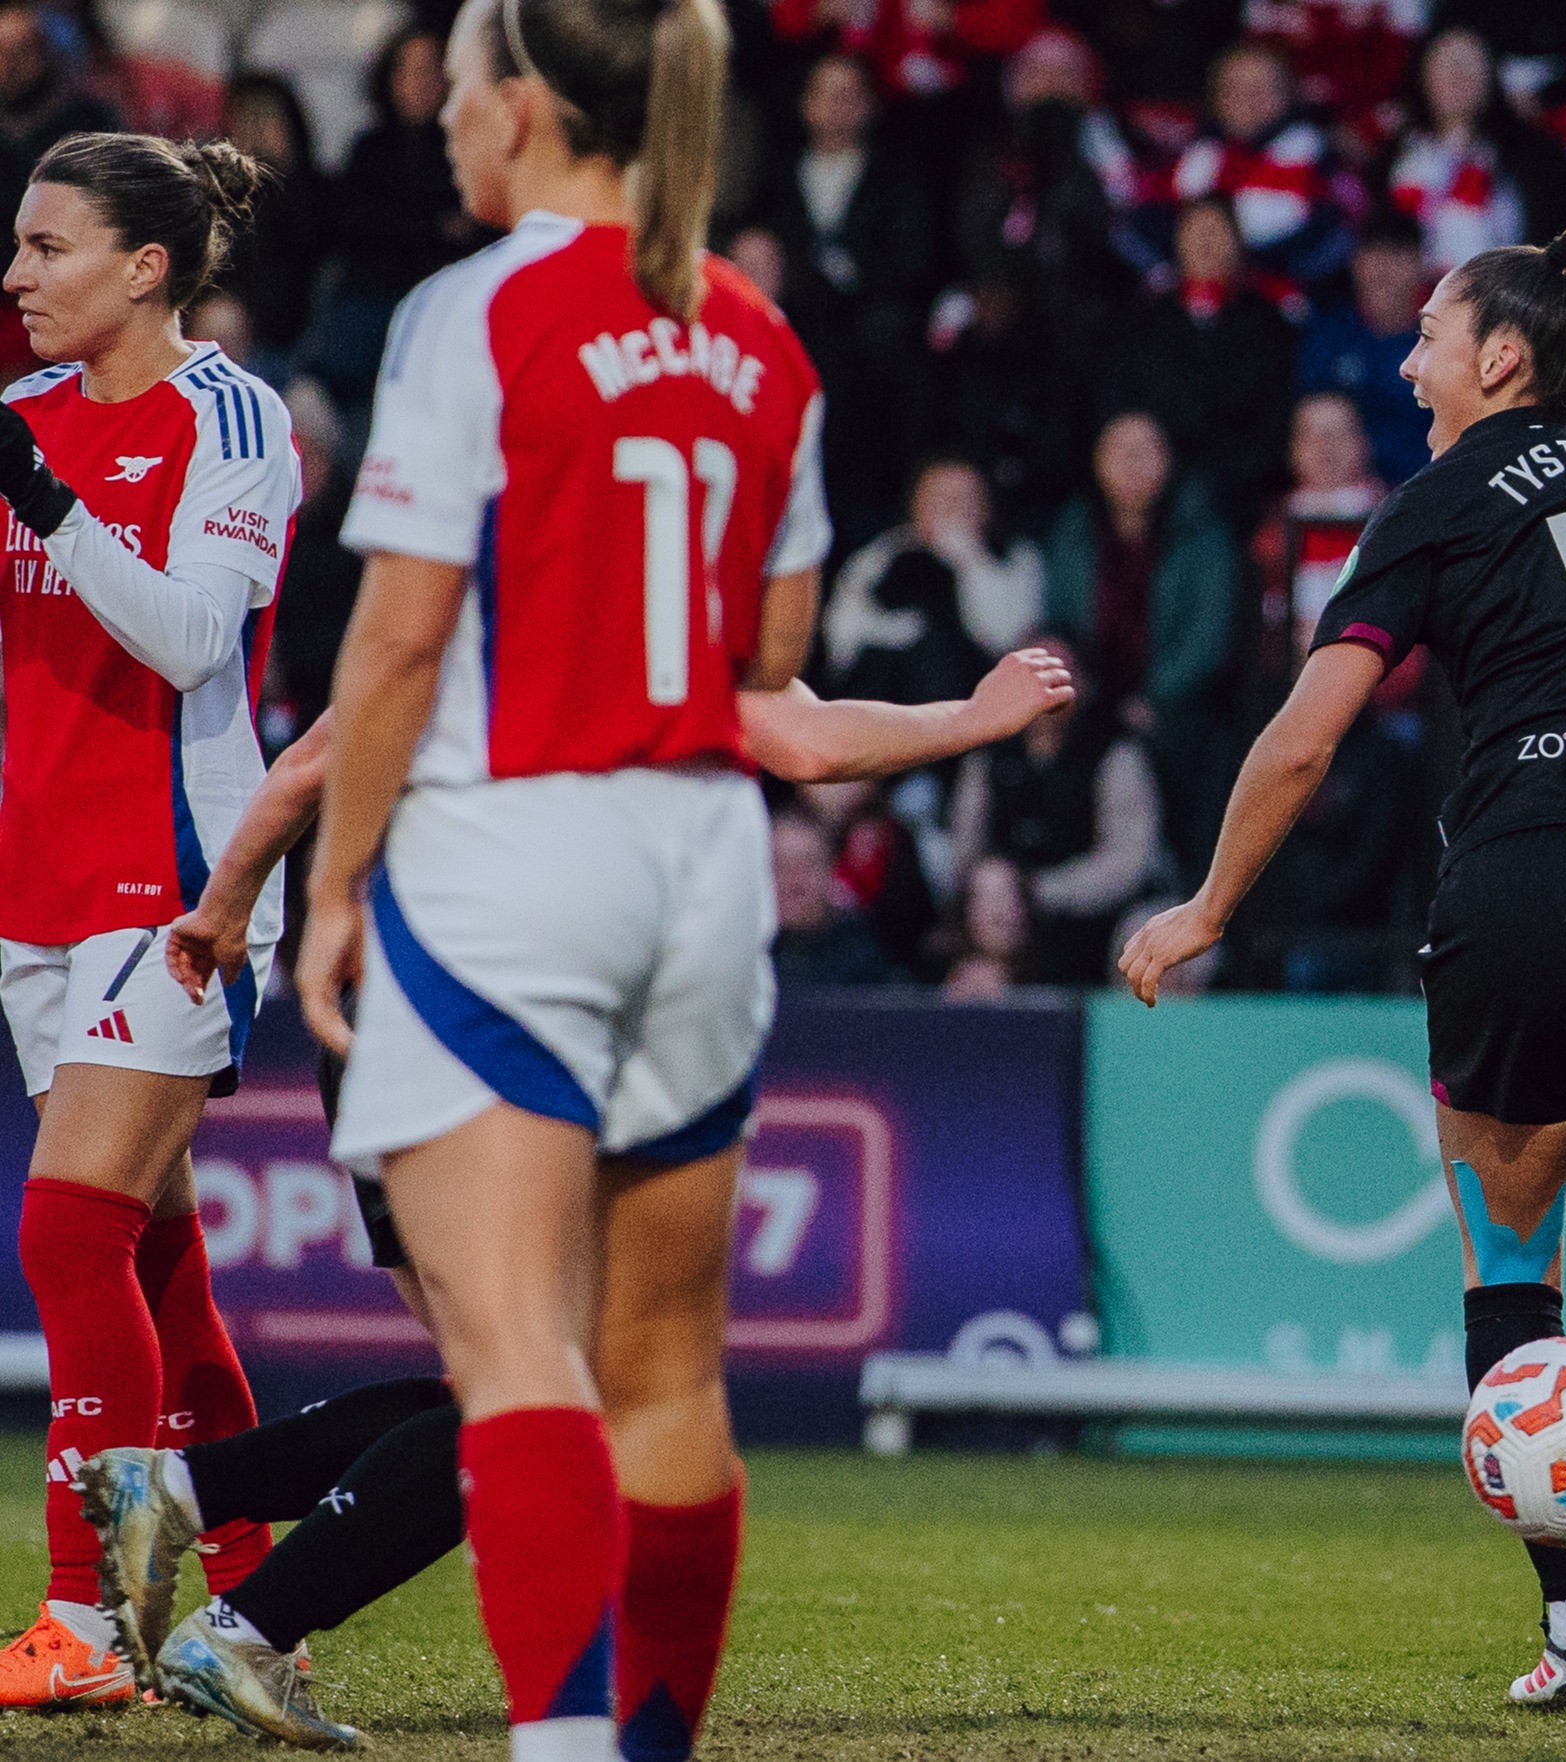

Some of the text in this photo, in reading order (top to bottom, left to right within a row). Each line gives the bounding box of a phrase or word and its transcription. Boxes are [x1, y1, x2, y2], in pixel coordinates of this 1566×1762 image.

[227, 506, 269, 533] VISIT
[203, 519, 278, 559] RWANDA
[14, 558, 38, 594] FLY
